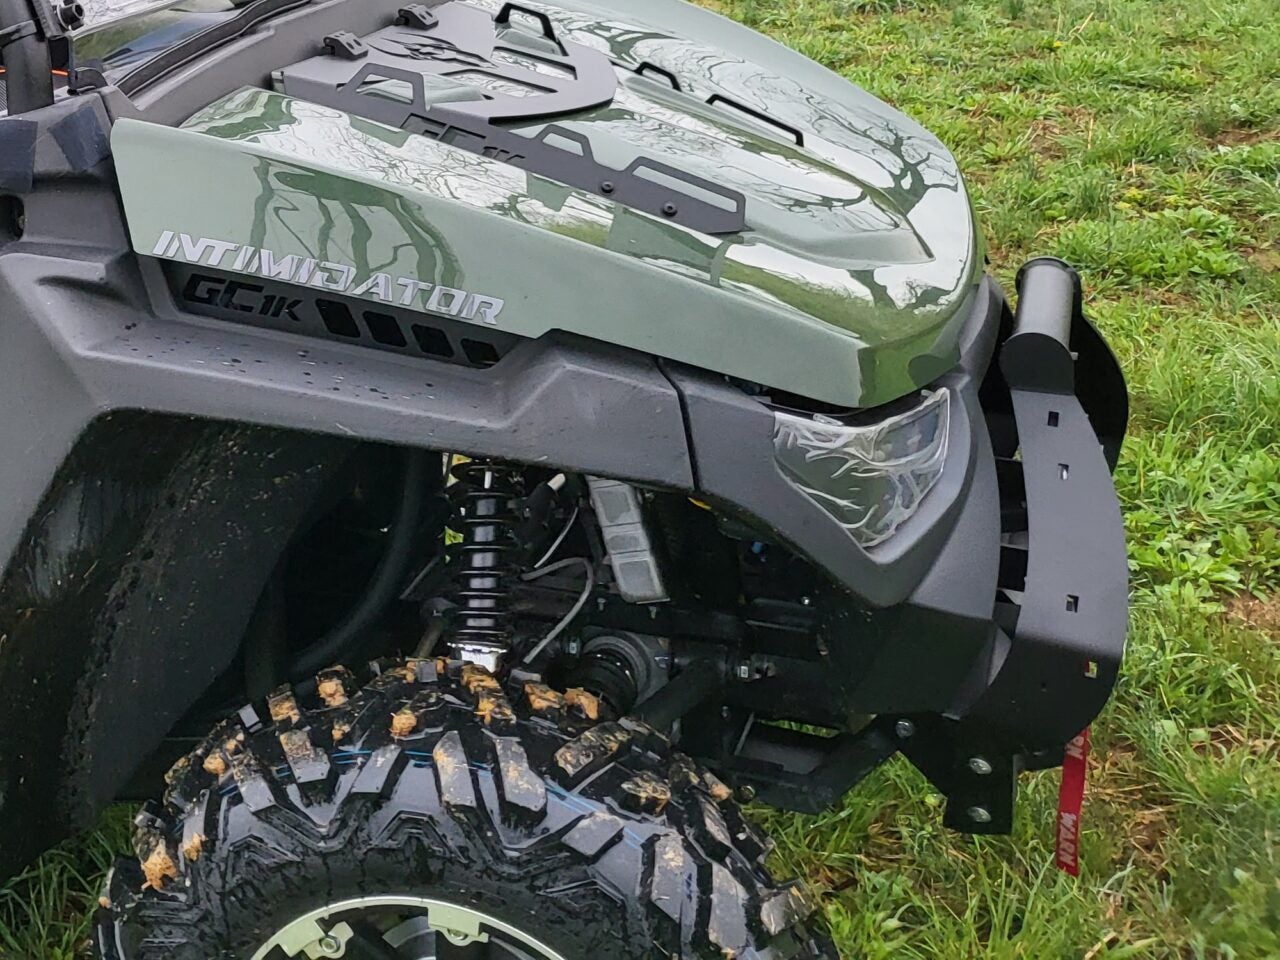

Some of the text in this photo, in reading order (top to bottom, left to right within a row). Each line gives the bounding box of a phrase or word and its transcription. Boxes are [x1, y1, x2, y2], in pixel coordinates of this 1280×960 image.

[152, 230, 505, 325] INTIMIDATOR
[182, 273, 304, 322] GC1K
[1059, 811, 1077, 868] WARN
